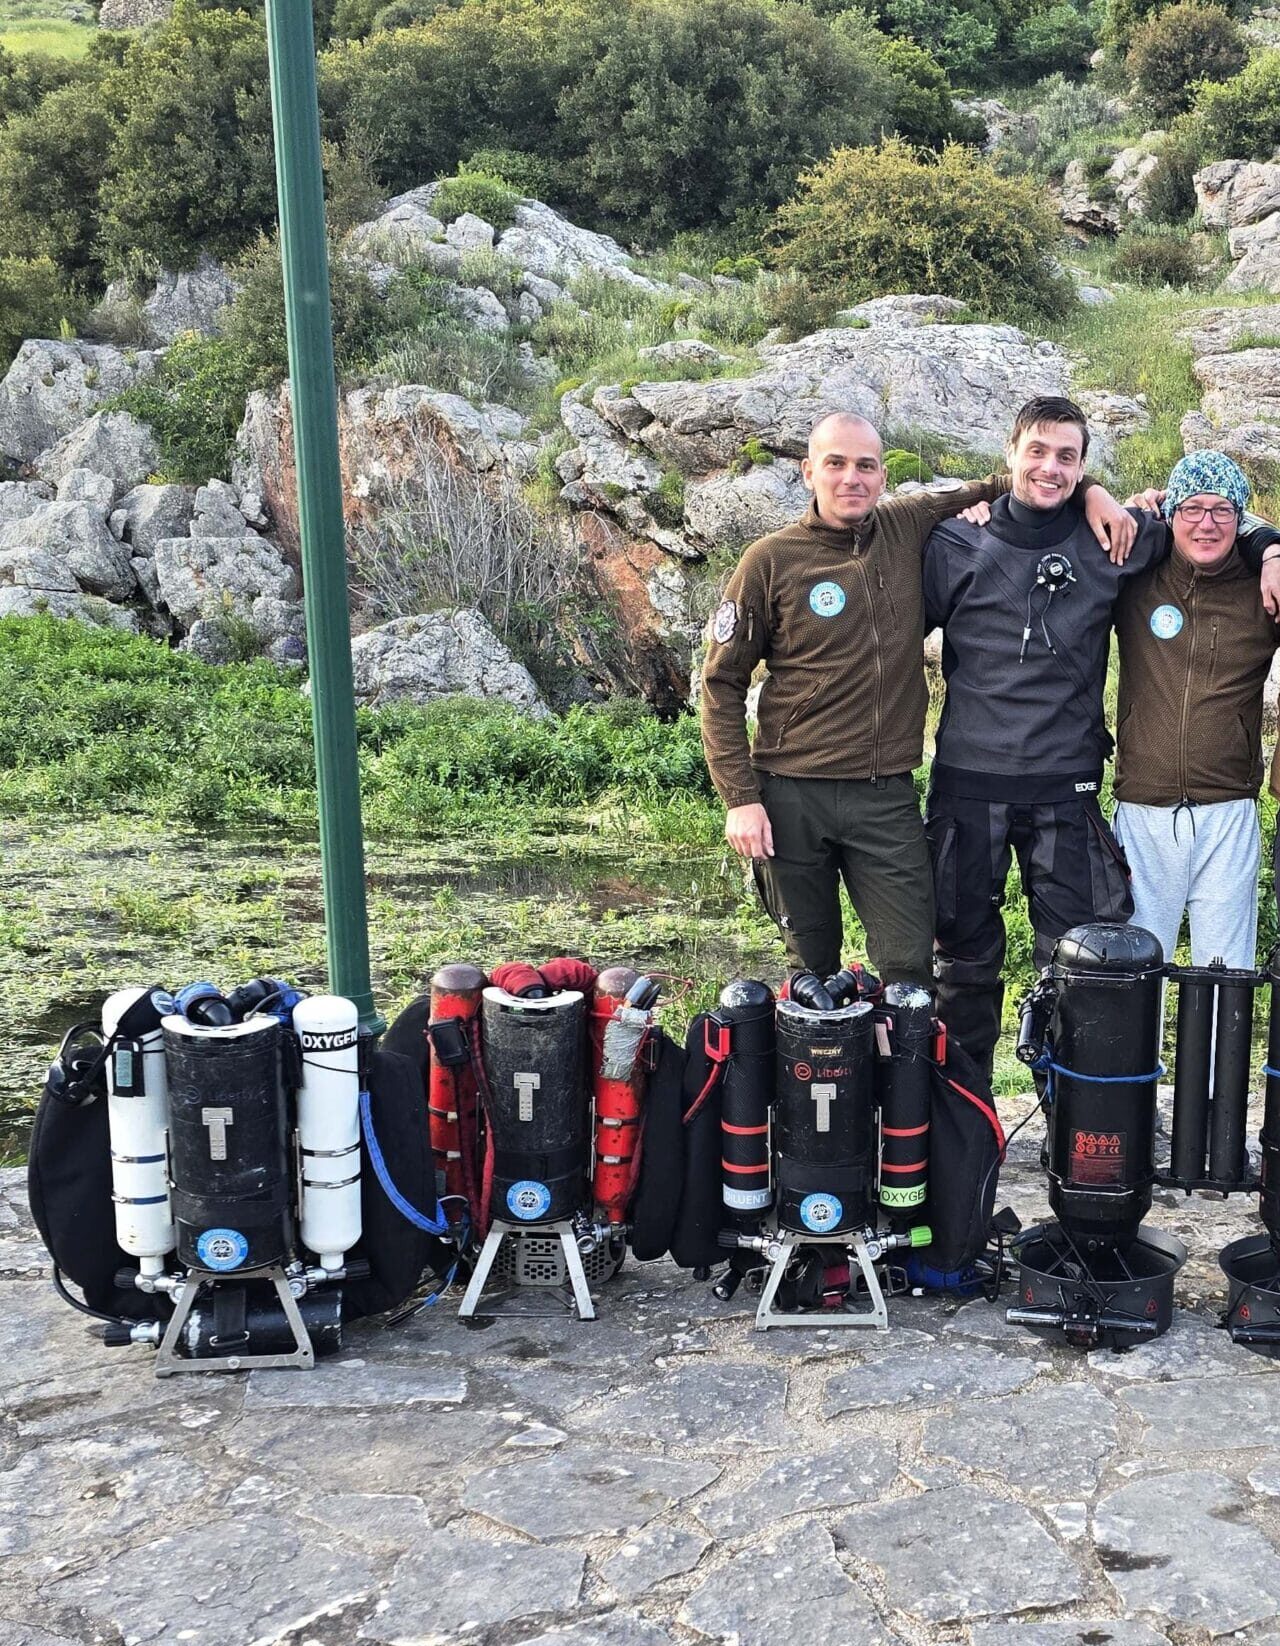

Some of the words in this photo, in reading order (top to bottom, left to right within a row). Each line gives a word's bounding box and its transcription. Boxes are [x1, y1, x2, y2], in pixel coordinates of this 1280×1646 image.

[1074, 781, 1098, 793] EDGE
[725, 1190, 768, 1205] DILUENT
[881, 1189, 925, 1202] OXYGE
